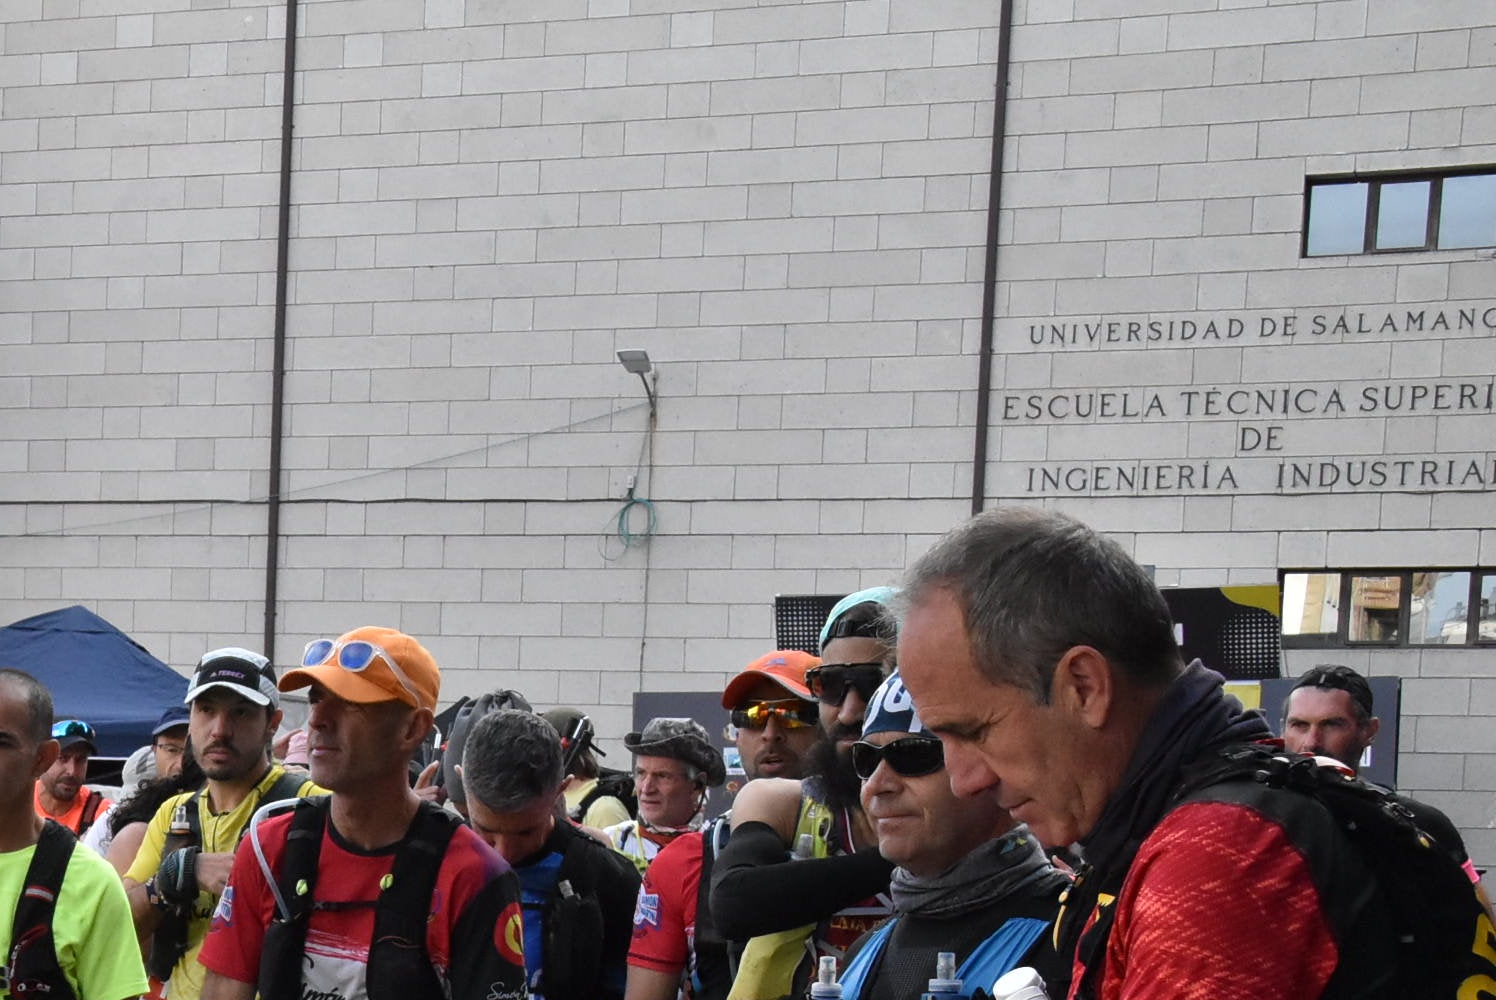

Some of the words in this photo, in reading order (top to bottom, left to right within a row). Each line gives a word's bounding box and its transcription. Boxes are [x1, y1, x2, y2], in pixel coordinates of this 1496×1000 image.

[1029, 318, 1245, 345] UNIVERSIDAD
[1259, 315, 1297, 338] DE
[1310, 307, 1496, 336] SALAMANC
[1002, 393, 1167, 421] ESCUELA
[1180, 387, 1346, 417] TÉCNICA
[1359, 382, 1495, 412] SUPERI
[1240, 426, 1284, 451] DE
[1026, 460, 1240, 492] INGENIERÍA
